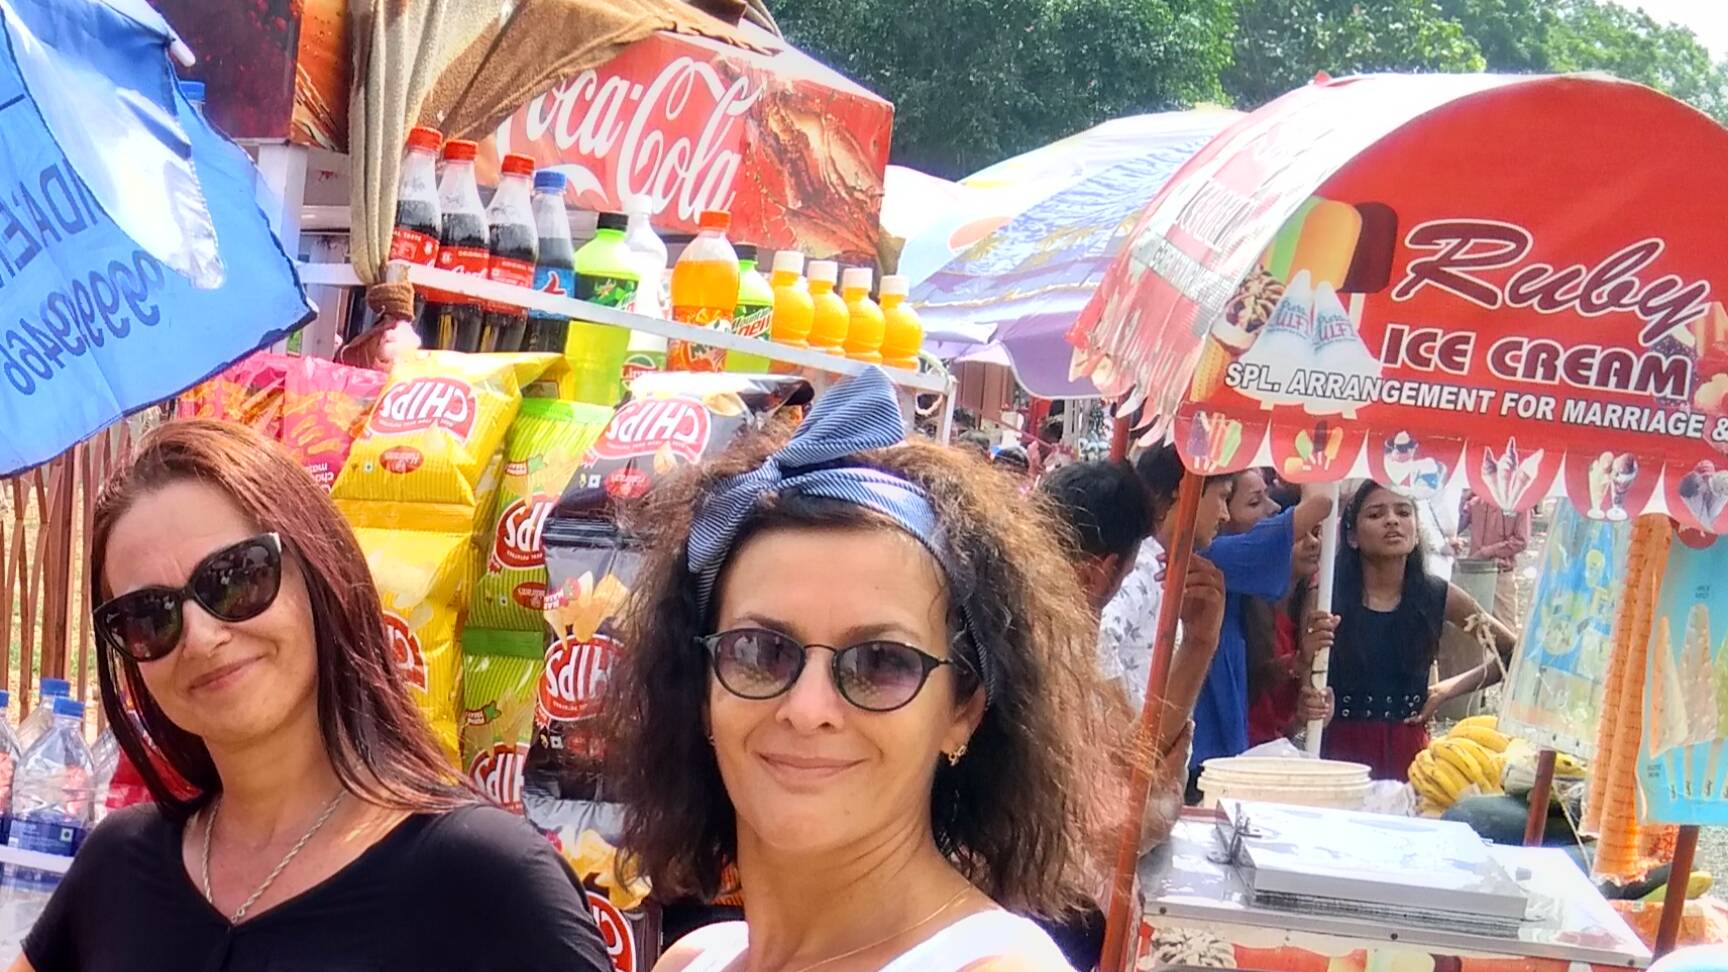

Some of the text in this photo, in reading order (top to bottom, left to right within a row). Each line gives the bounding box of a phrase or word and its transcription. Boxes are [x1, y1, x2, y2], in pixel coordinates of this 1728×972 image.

[1390, 217, 1711, 348] Ruby
[1379, 323, 1693, 402] ICE CREAM
[378, 382, 469, 423] CHIPS
[606, 400, 699, 441] CHIPS
[1225, 362, 1281, 394] SPL.
[1287, 367, 1494, 417] ARRANGEMENT
[1499, 391, 1556, 421] FOR
[1561, 397, 1706, 442] MARRIAGE
[503, 502, 554, 552] IPS
